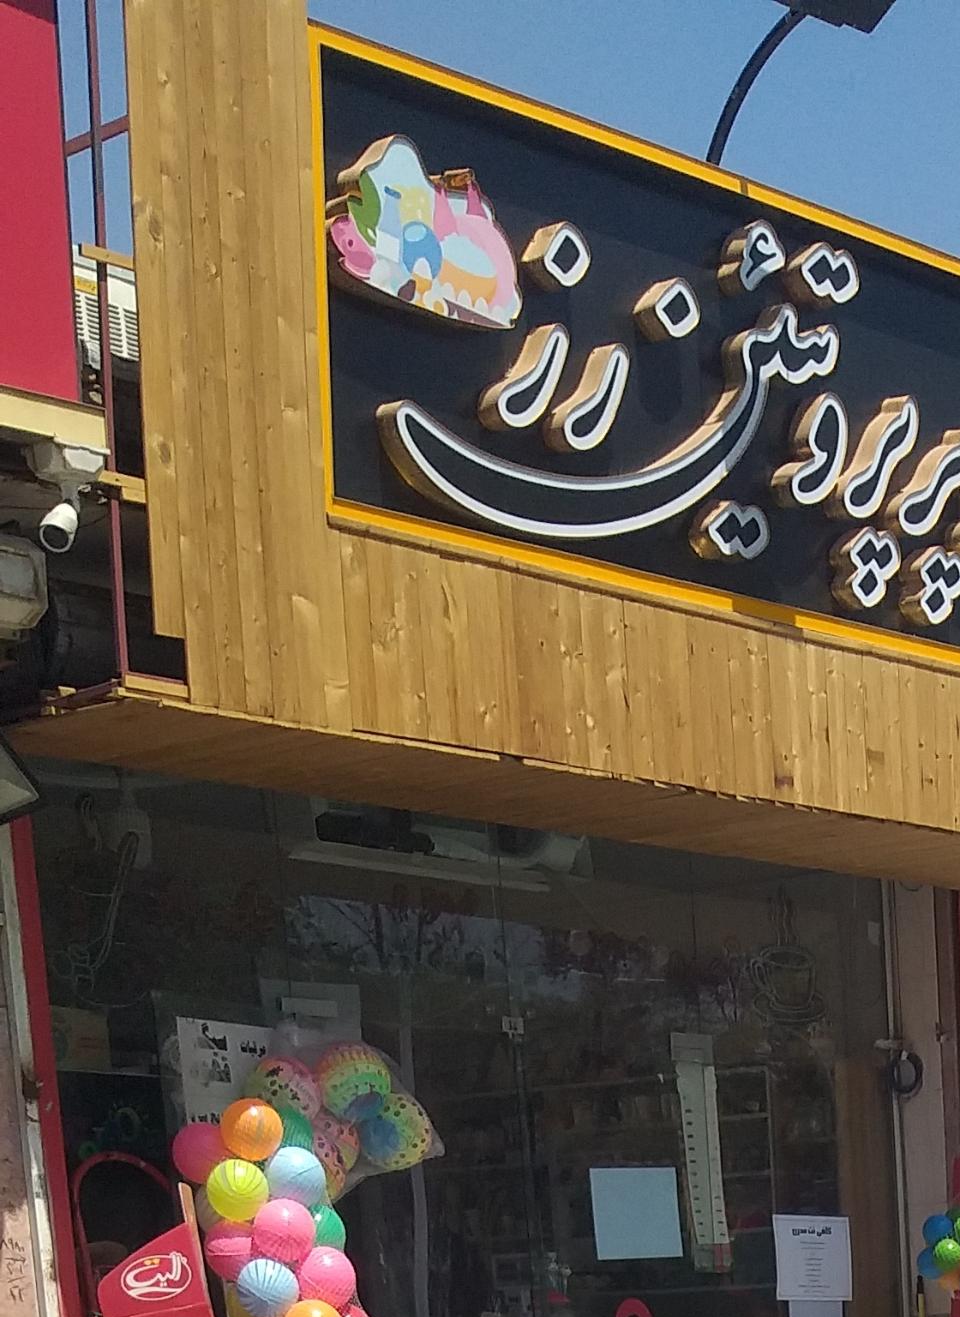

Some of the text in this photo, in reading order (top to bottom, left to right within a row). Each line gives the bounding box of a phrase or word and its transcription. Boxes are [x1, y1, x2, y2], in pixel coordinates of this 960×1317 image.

[383, 218, 920, 611] پروتئین
[480, 220, 630, 452] رز
[125, 1252, 186, 1288] الیت
